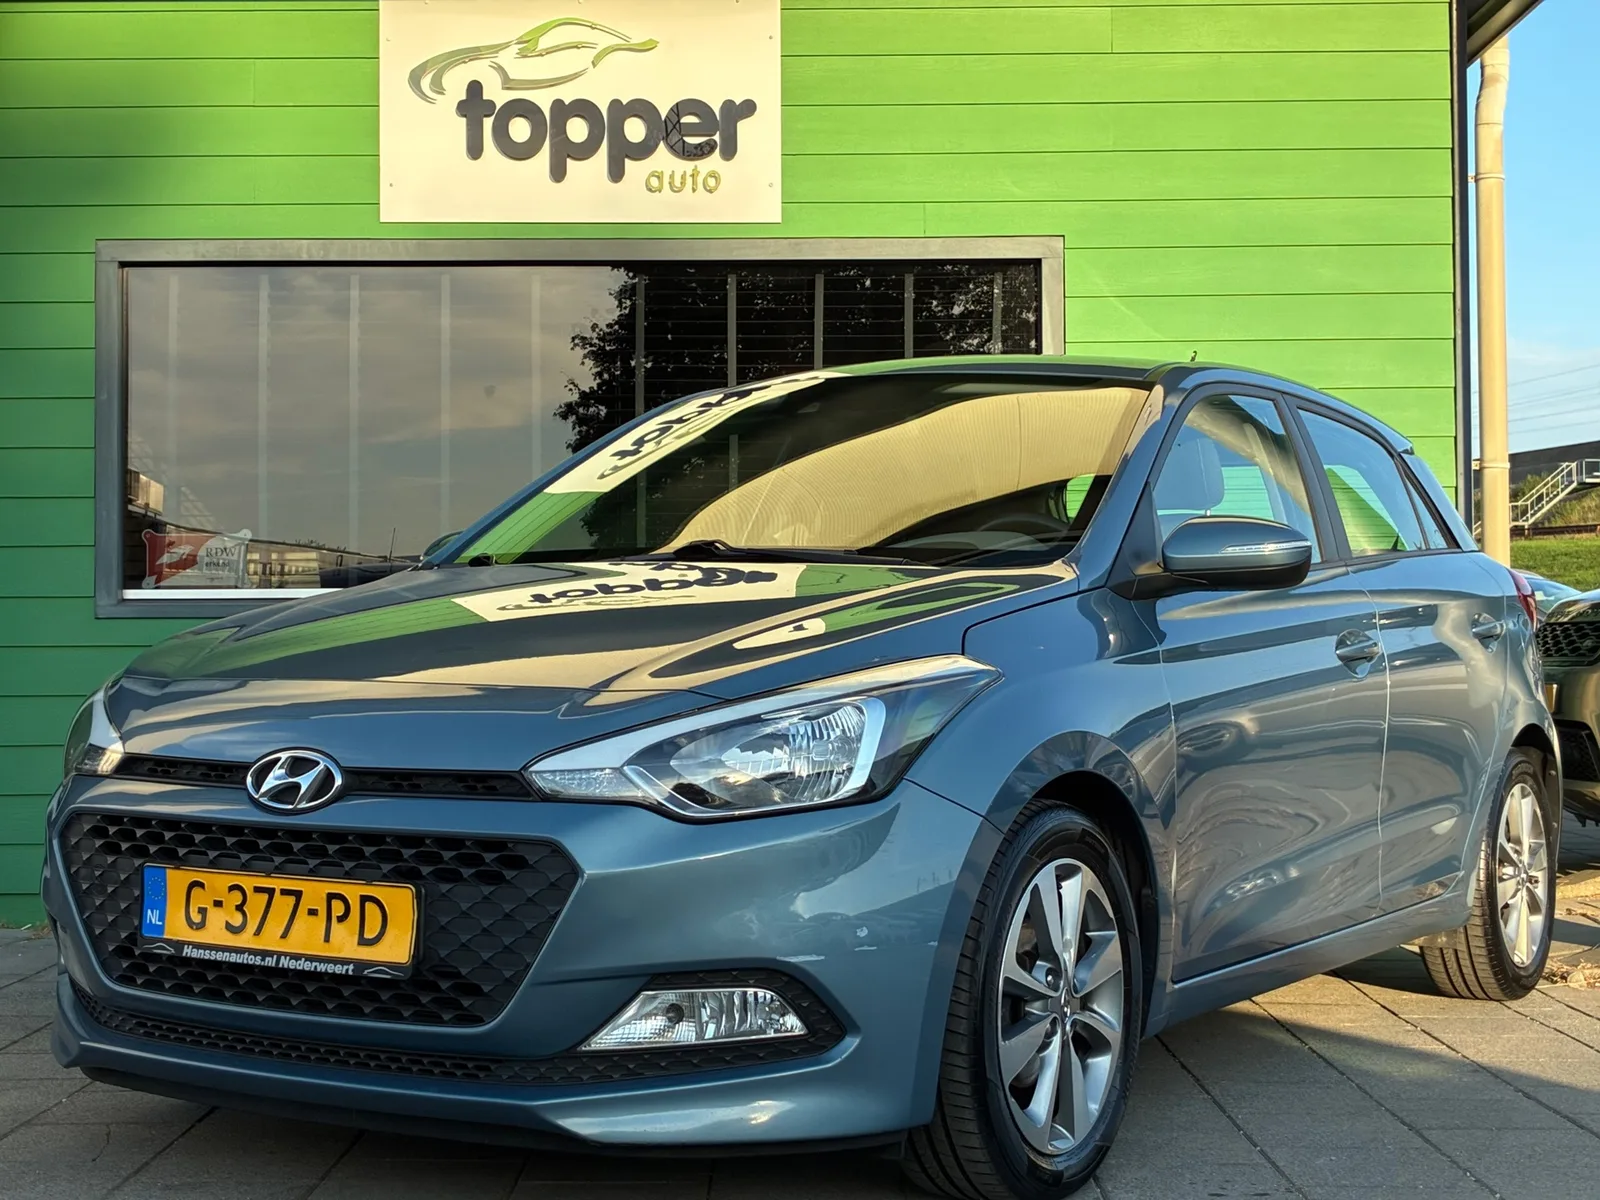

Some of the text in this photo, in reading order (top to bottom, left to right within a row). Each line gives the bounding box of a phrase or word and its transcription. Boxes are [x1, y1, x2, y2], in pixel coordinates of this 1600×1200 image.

[455, 79, 757, 184] topper
[645, 165, 721, 194] auto
[205, 547, 237, 558] RDW
[146, 908, 163, 925] NL
[184, 879, 389, 947] G-377-PD
[182, 944, 354, 975] Hanssenautos.nl Nederweert
